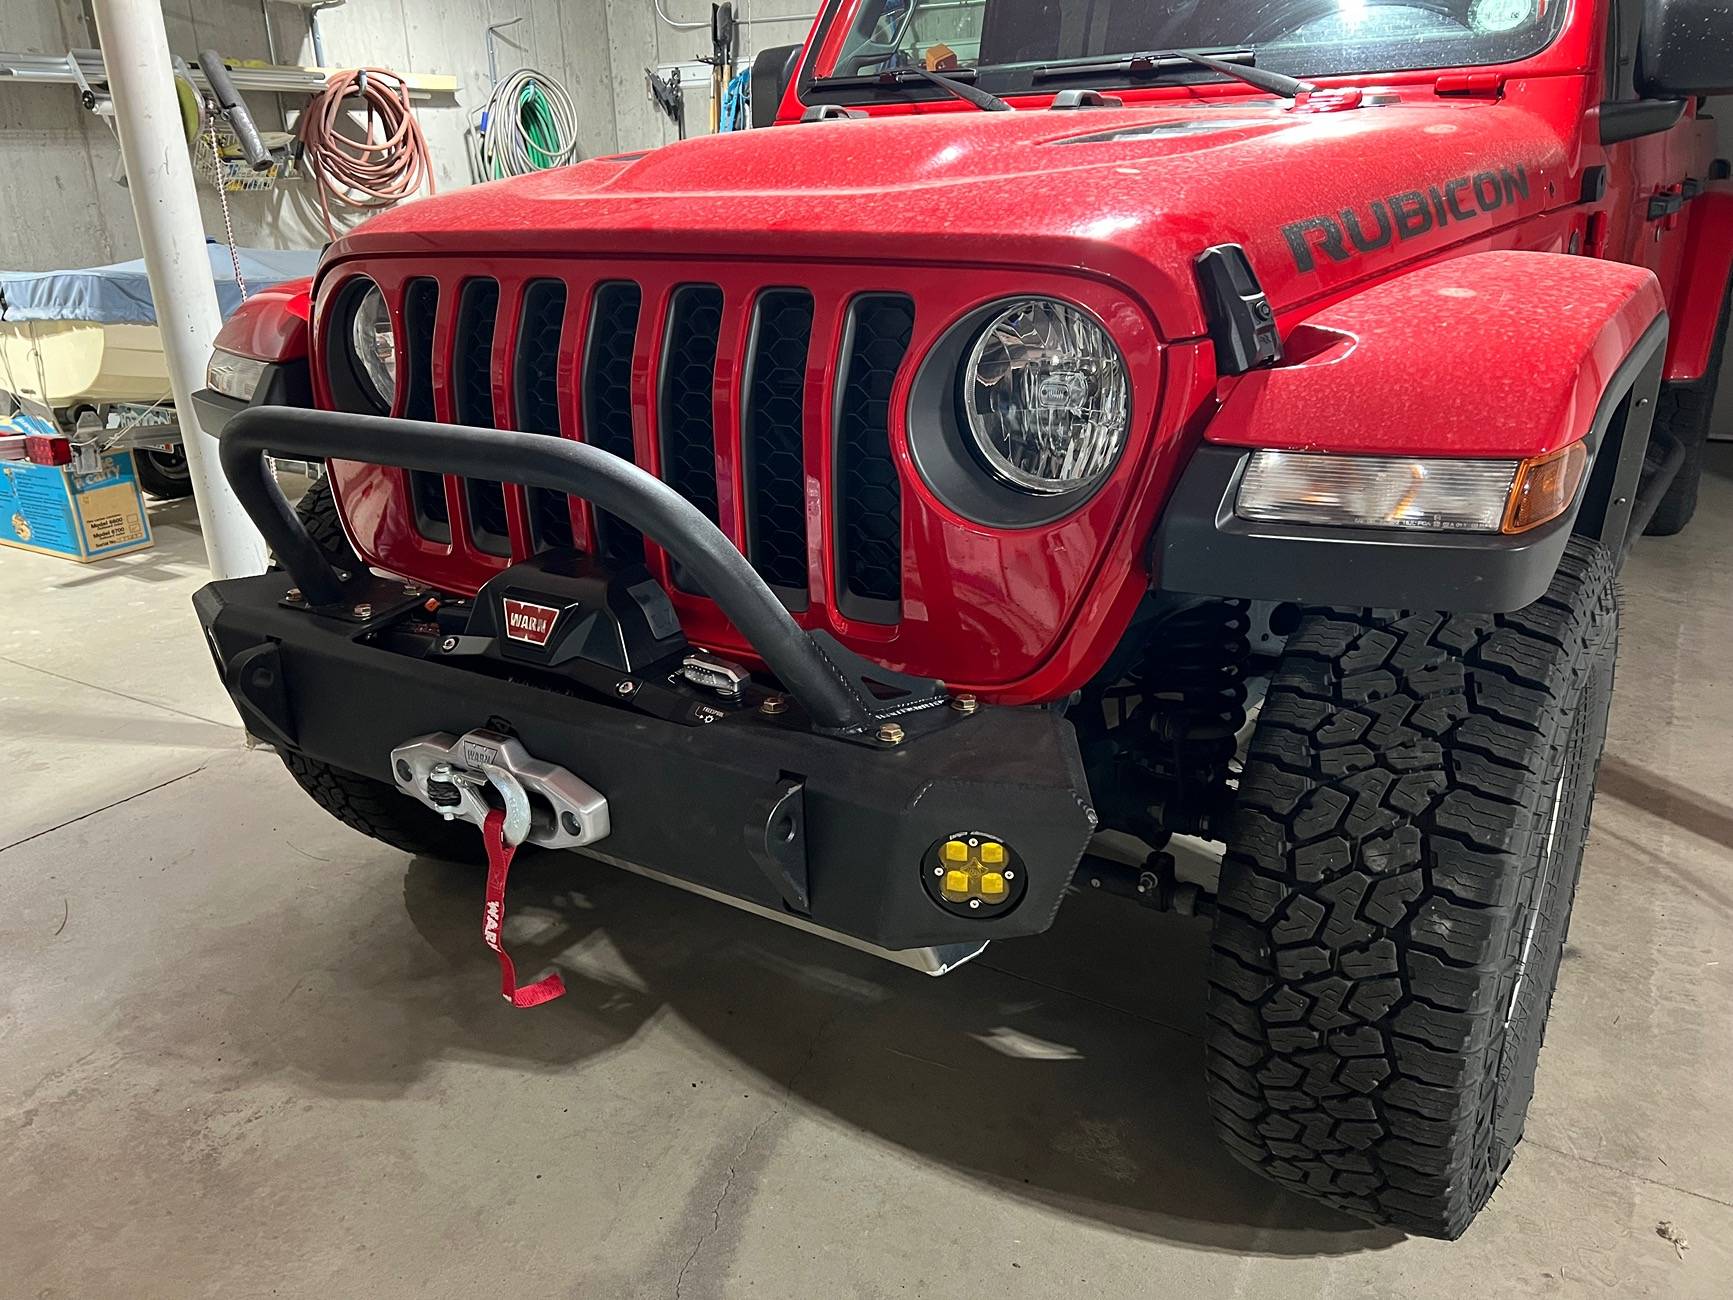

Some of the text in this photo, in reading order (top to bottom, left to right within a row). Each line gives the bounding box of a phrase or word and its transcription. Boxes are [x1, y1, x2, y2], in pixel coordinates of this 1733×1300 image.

[1280, 163, 1529, 273] RUBICON
[90, 520, 108, 528] Model
[93, 530, 110, 538] Model
[510, 612, 547, 634] WARN
[467, 749, 491, 763] WARN
